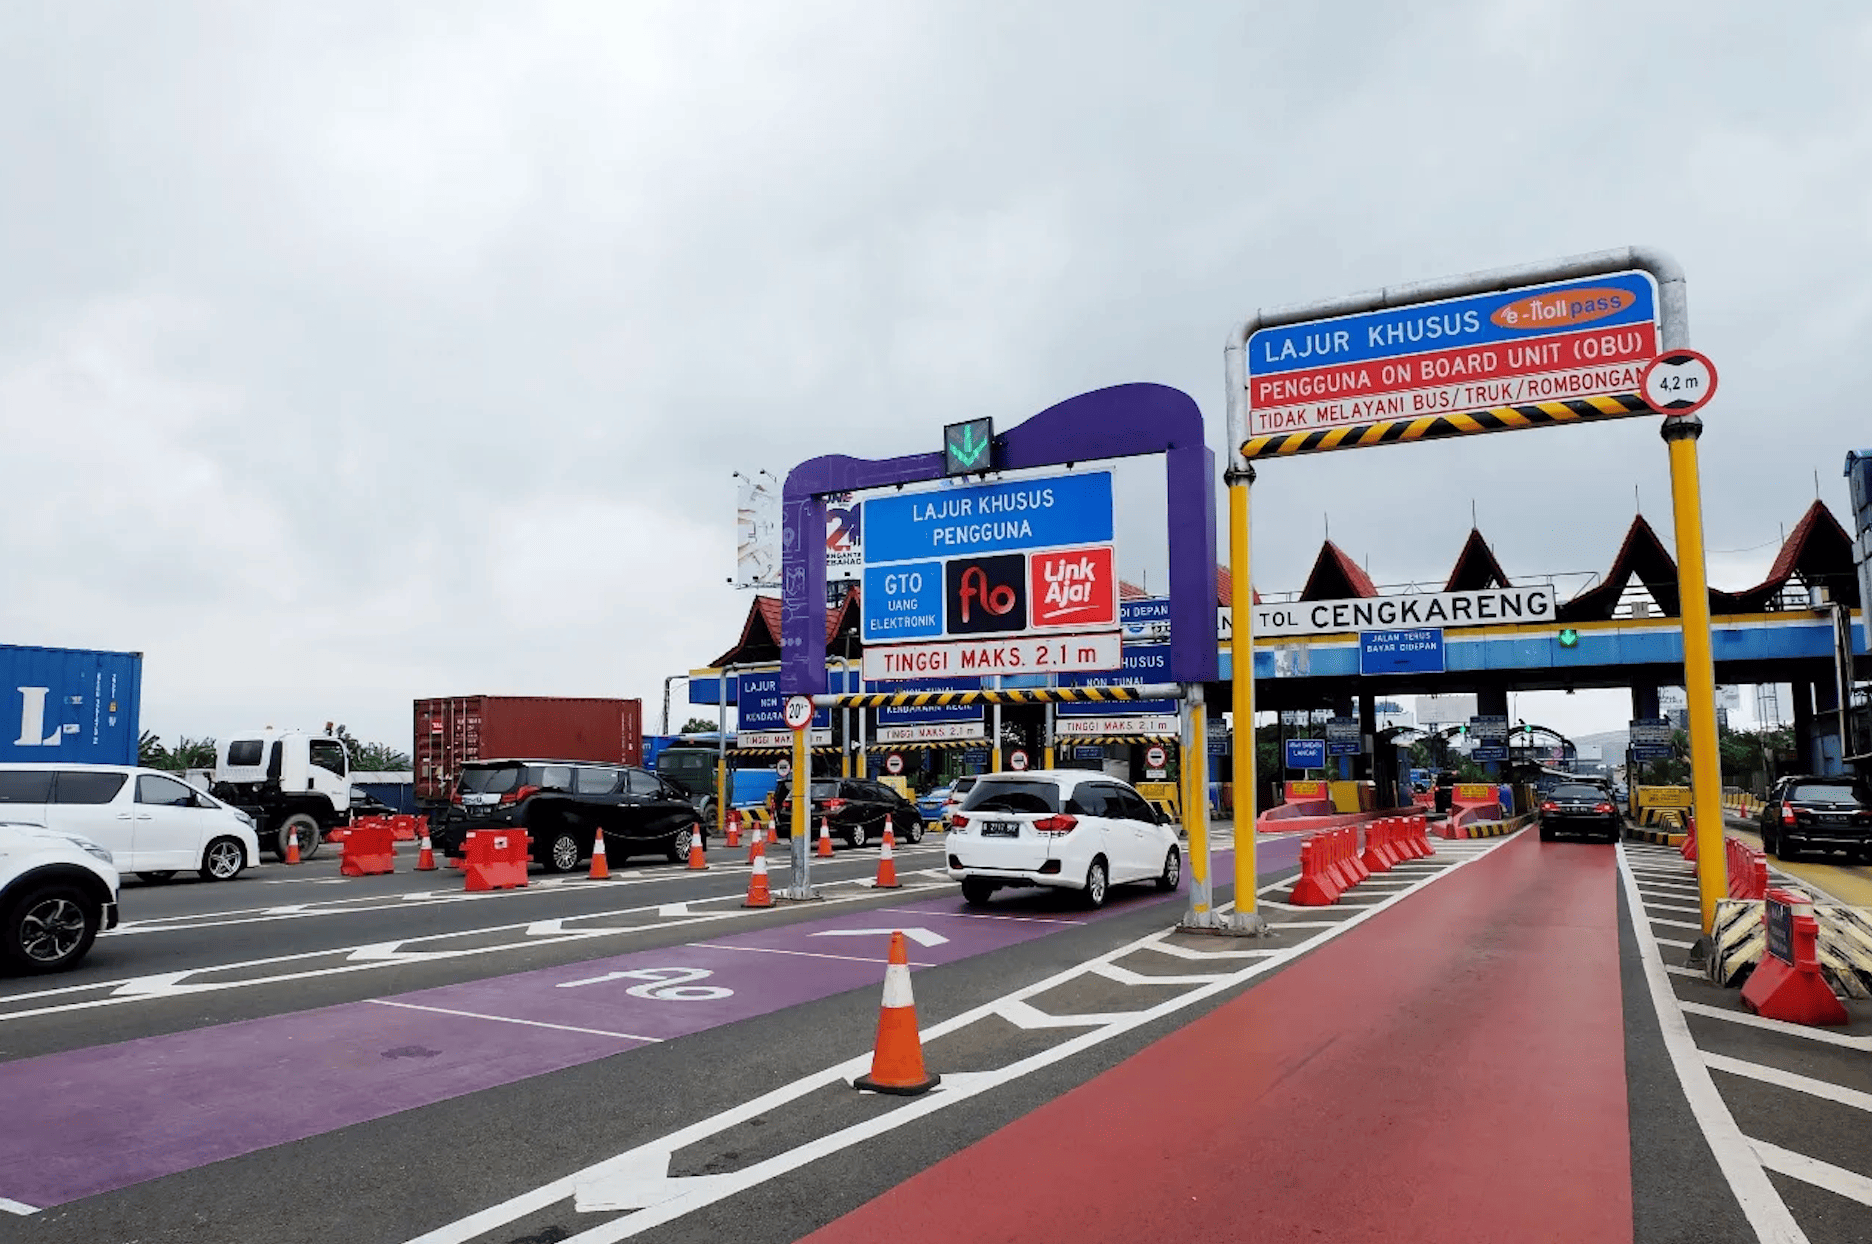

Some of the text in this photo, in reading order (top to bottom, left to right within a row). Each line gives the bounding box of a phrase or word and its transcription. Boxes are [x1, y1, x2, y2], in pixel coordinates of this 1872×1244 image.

[1265, 331, 1349, 362] LAJUR
[1368, 310, 1480, 348] KHUSUS
[1570, 295, 1622, 319] pass
[1260, 332, 1642, 401] PENGGUNA ON BOARD UNIT (OBU)
[1659, 376, 1698, 393] 4,2 m
[1259, 408, 1308, 430] TIDAK
[1316, 397, 1405, 423] MELAYANI
[912, 488, 1055, 523] LAJUR KHUSUS
[932, 519, 1032, 546] PENGGUNA
[1043, 557, 1096, 583] Link
[884, 572, 922, 595] GTO
[1043, 579, 1092, 608] Aja!
[888, 599, 918, 611] UANG
[1133, 605, 1169, 617] DEPAN
[1259, 611, 1298, 627] TOL
[1311, 592, 1548, 629] CENGKARENG
[870, 614, 936, 630] ELEKTRONIK
[884, 651, 948, 672] TINGGI
[961, 648, 1026, 669] MAKS.
[1077, 648, 1096, 664] m
[1123, 655, 1165, 668] HUSUS
[744, 680, 776, 693] LAJUR
